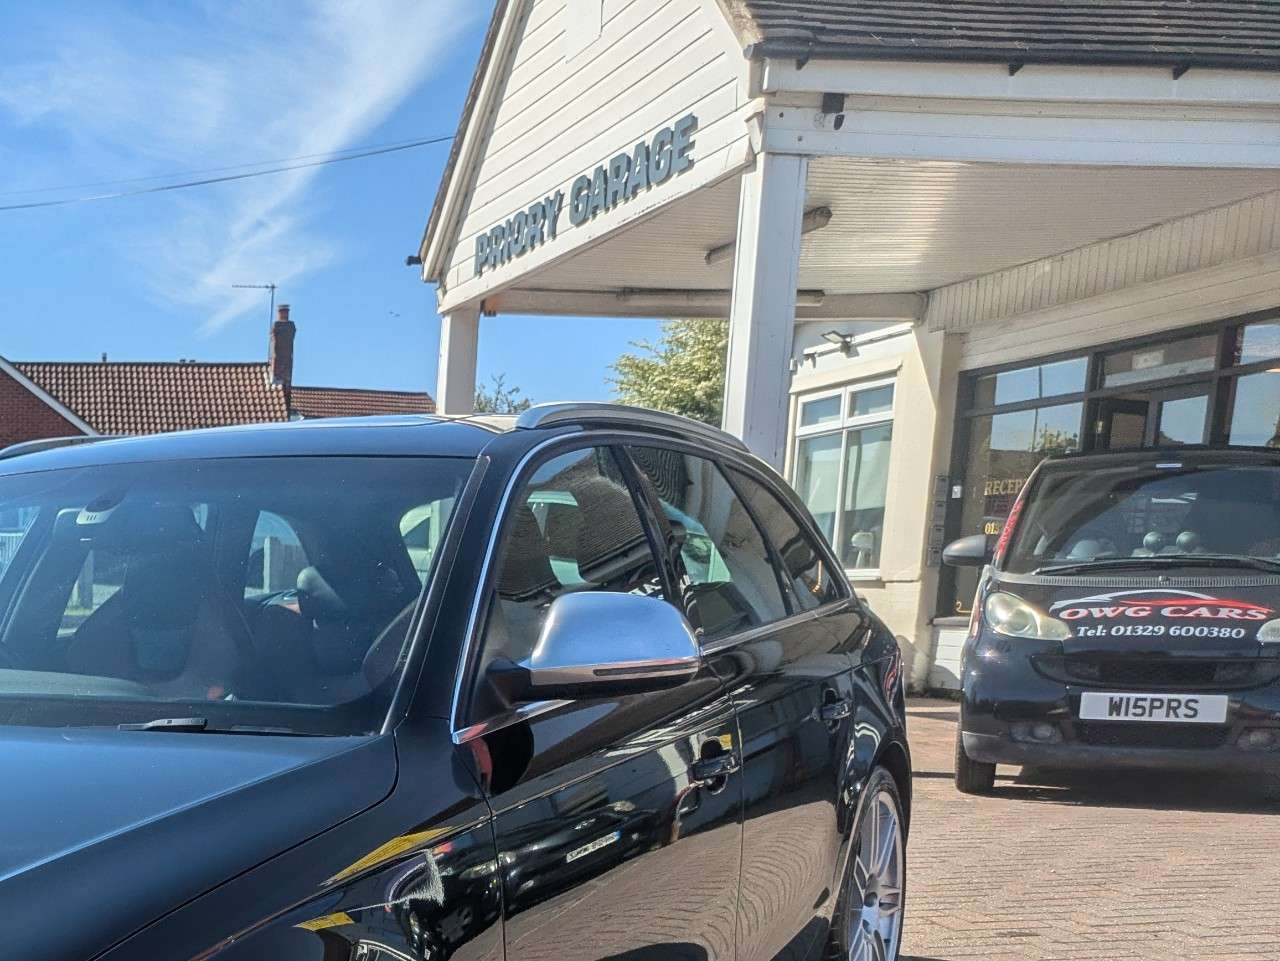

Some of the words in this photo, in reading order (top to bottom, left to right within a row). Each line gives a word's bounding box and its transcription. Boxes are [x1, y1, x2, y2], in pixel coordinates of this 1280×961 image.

[474, 189, 565, 280] PRIORY
[569, 112, 699, 229] GARAGE
[983, 477, 1027, 496] RECEP
[1058, 606, 1152, 620] OWG
[1160, 606, 1269, 621] CARS
[1110, 625, 1166, 638] 01329
[1169, 625, 1246, 639] 600380
